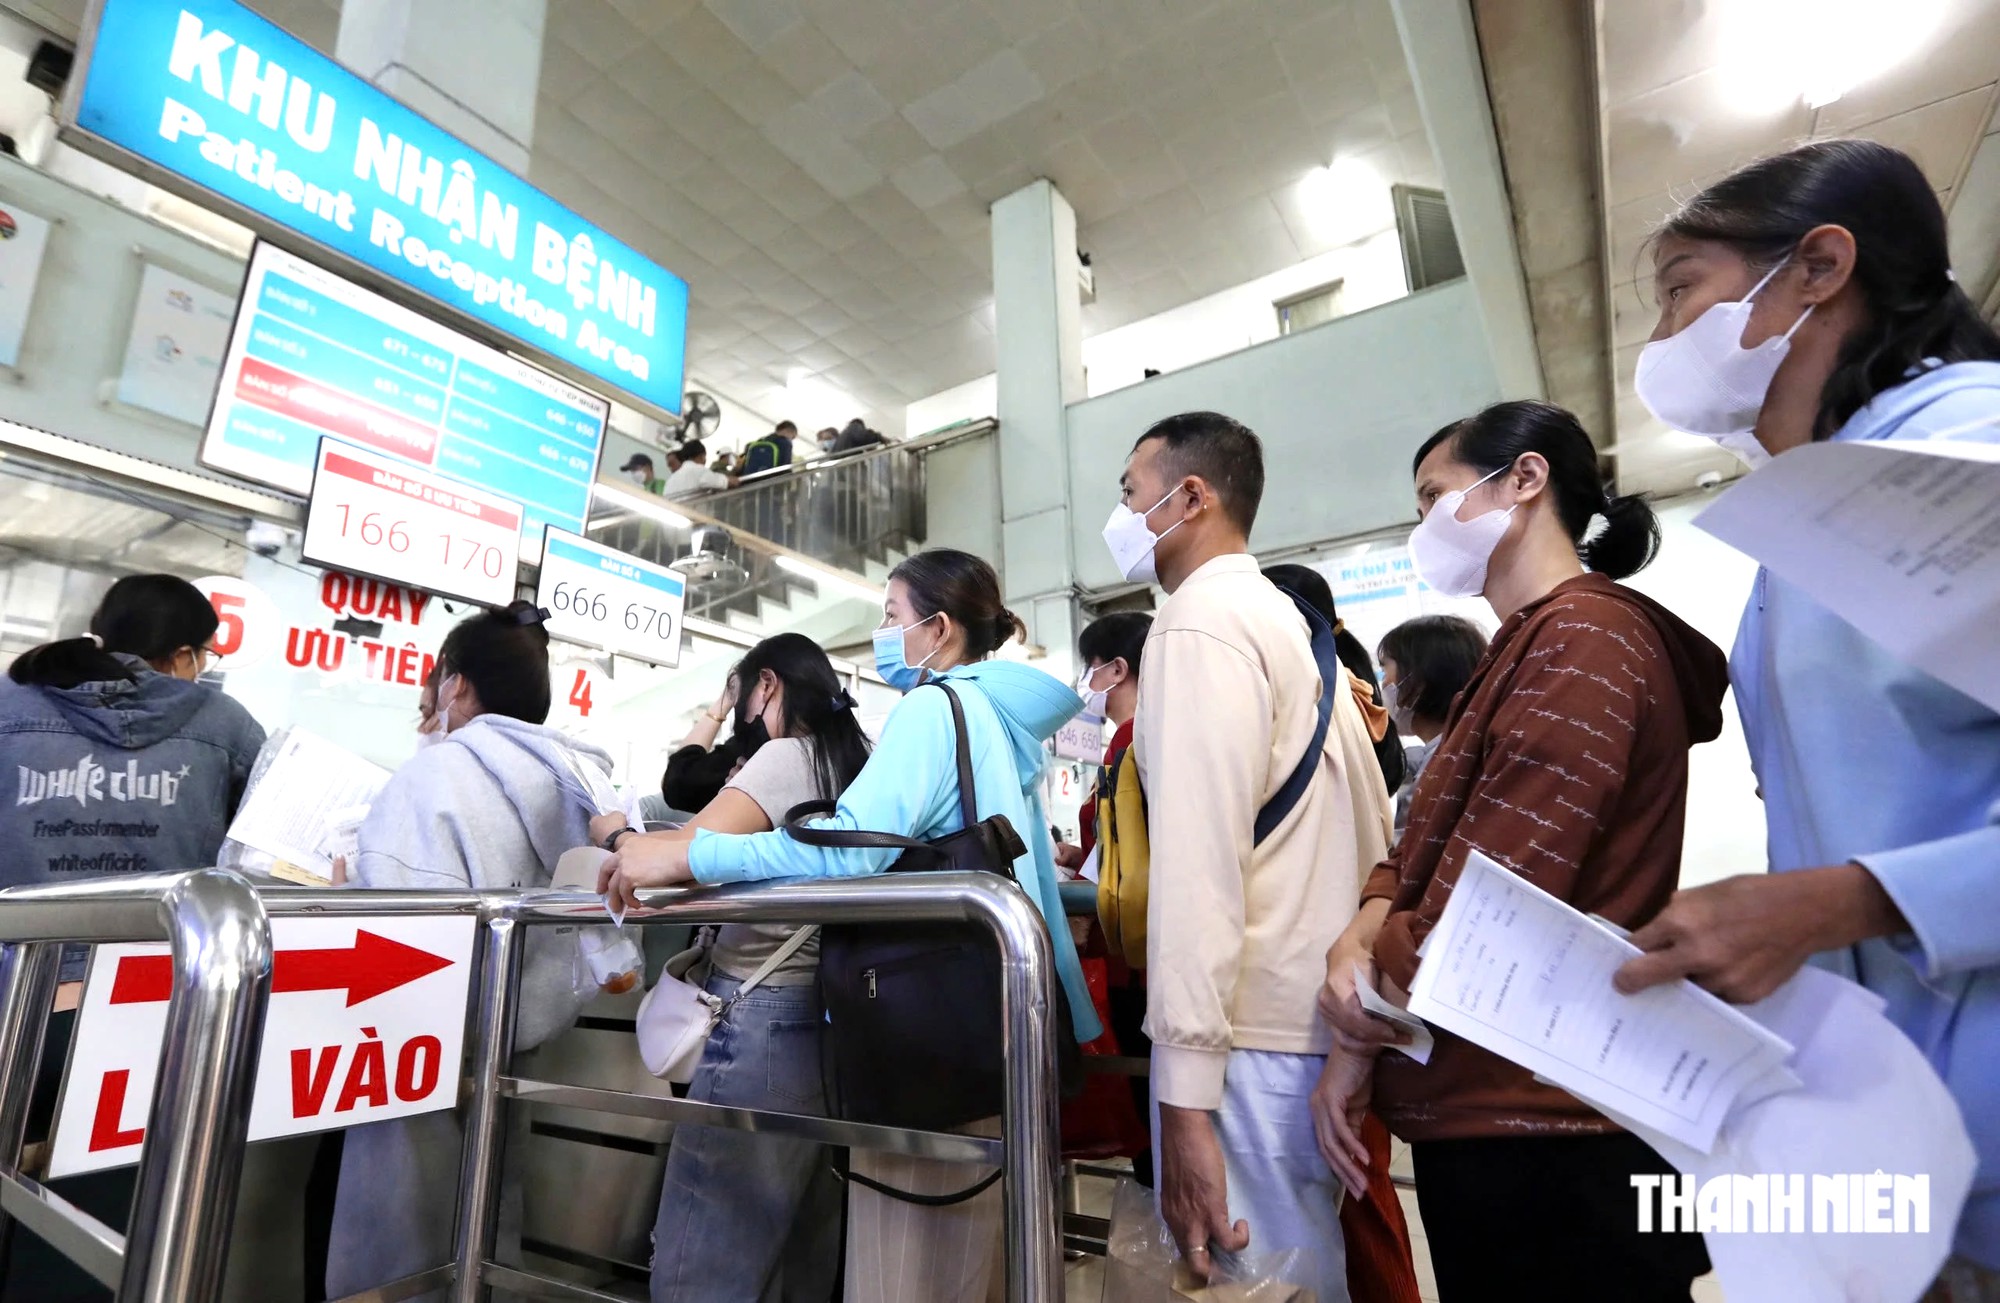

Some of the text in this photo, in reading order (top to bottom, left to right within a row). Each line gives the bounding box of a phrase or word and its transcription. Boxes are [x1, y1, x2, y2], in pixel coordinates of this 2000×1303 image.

[168, 9, 656, 337] KHU NHẬN BỆNH
[159, 96, 649, 381] Patient Reception Area
[336, 504, 502, 578] 166 170
[208, 591, 246, 655] 5
[553, 582, 672, 639] 666 670
[285, 627, 345, 672] ƯU
[569, 669, 592, 717] 4
[1082, 732, 1099, 751] 650
[1061, 769, 1069, 796] 2
[290, 1026, 442, 1119] VÀO
